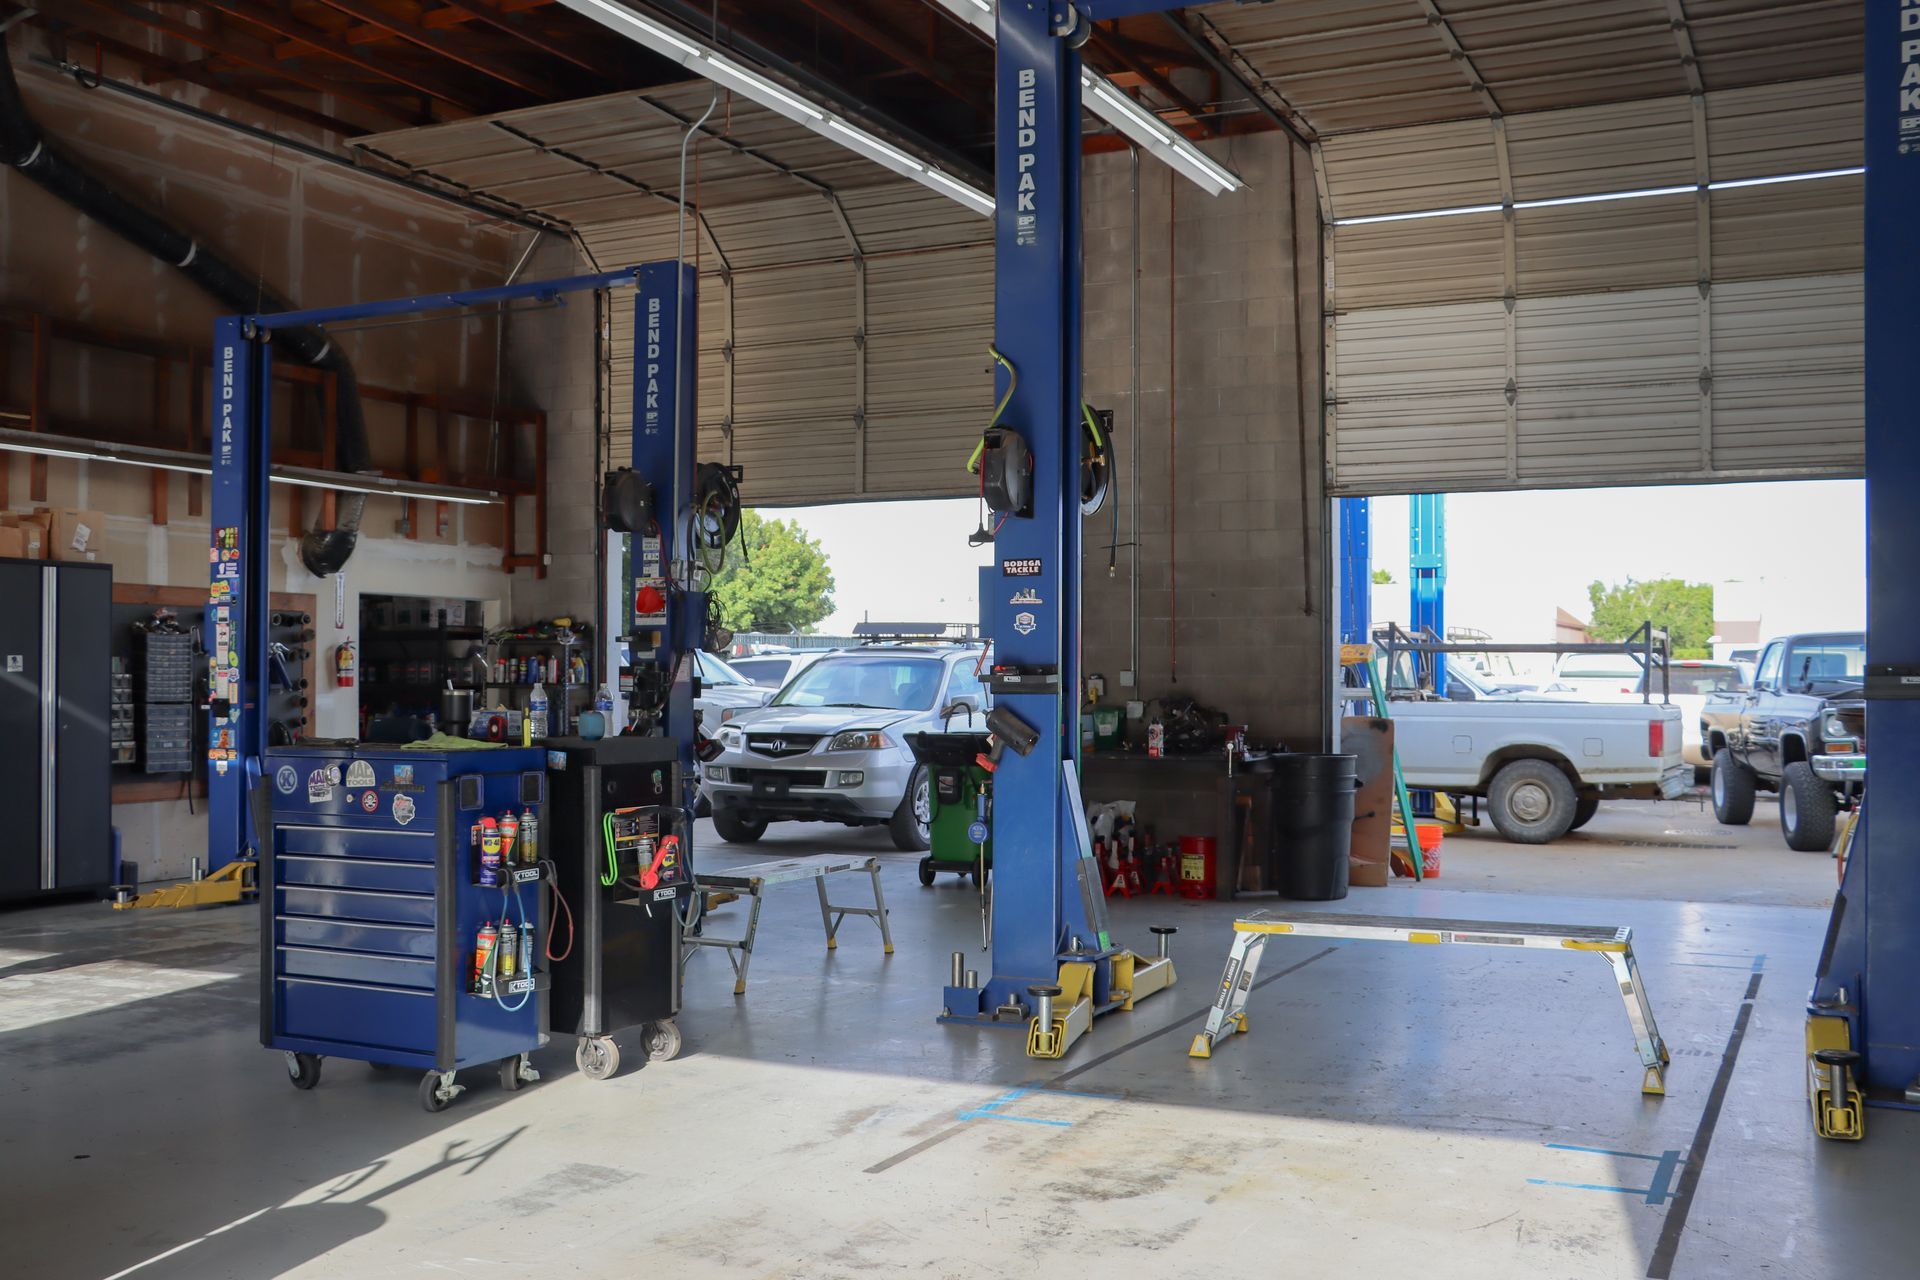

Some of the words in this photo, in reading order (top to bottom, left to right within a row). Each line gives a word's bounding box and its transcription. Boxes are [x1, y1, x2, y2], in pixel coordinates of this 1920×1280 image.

[1018, 69, 1035, 148] BEND
[1018, 153, 1035, 212] PAK
[648, 298, 660, 359] BEND
[223, 346, 233, 400] BEND
[647, 364, 658, 408] PAK
[222, 403, 232, 443] PAK
[309, 770, 327, 784] MA
[347, 761, 374, 779] MAC
